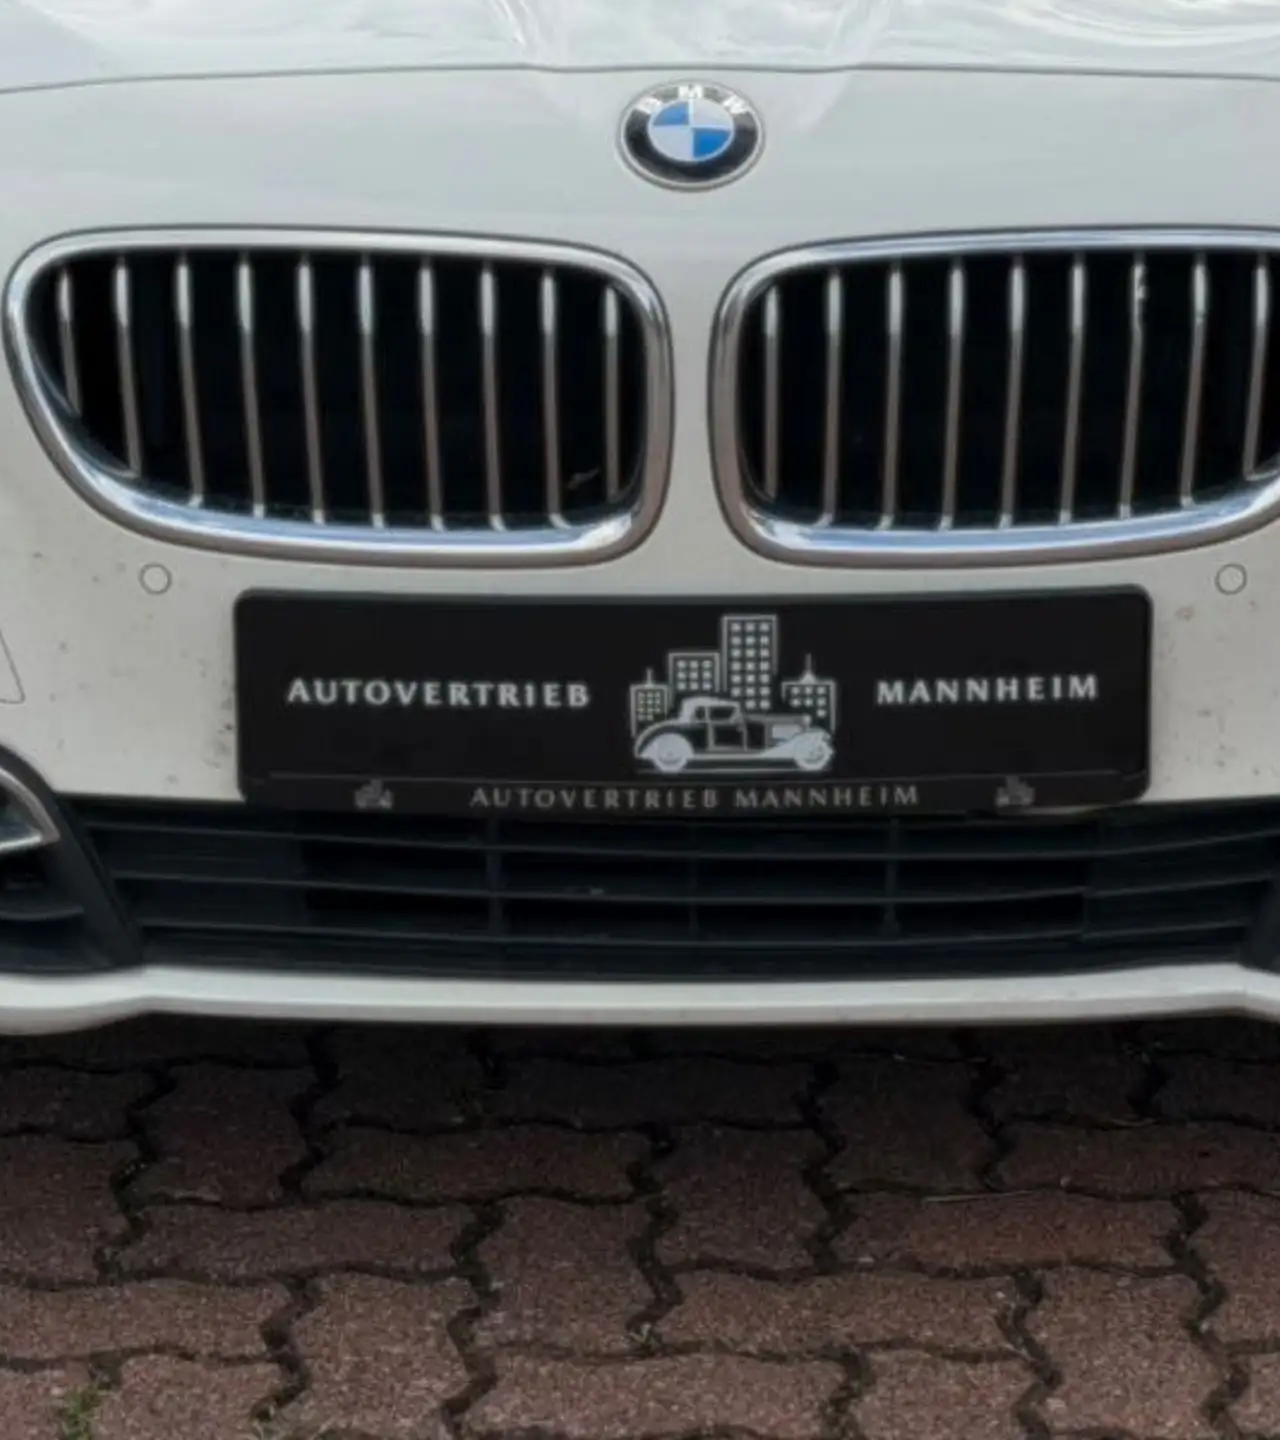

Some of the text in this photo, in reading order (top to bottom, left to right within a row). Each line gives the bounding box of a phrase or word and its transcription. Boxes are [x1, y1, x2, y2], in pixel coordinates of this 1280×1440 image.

[287, 673, 1099, 708] AUTOVERTRIEB MANNHEIM
[469, 783, 918, 809] AUTOVERTRIEB MANNHEIM
